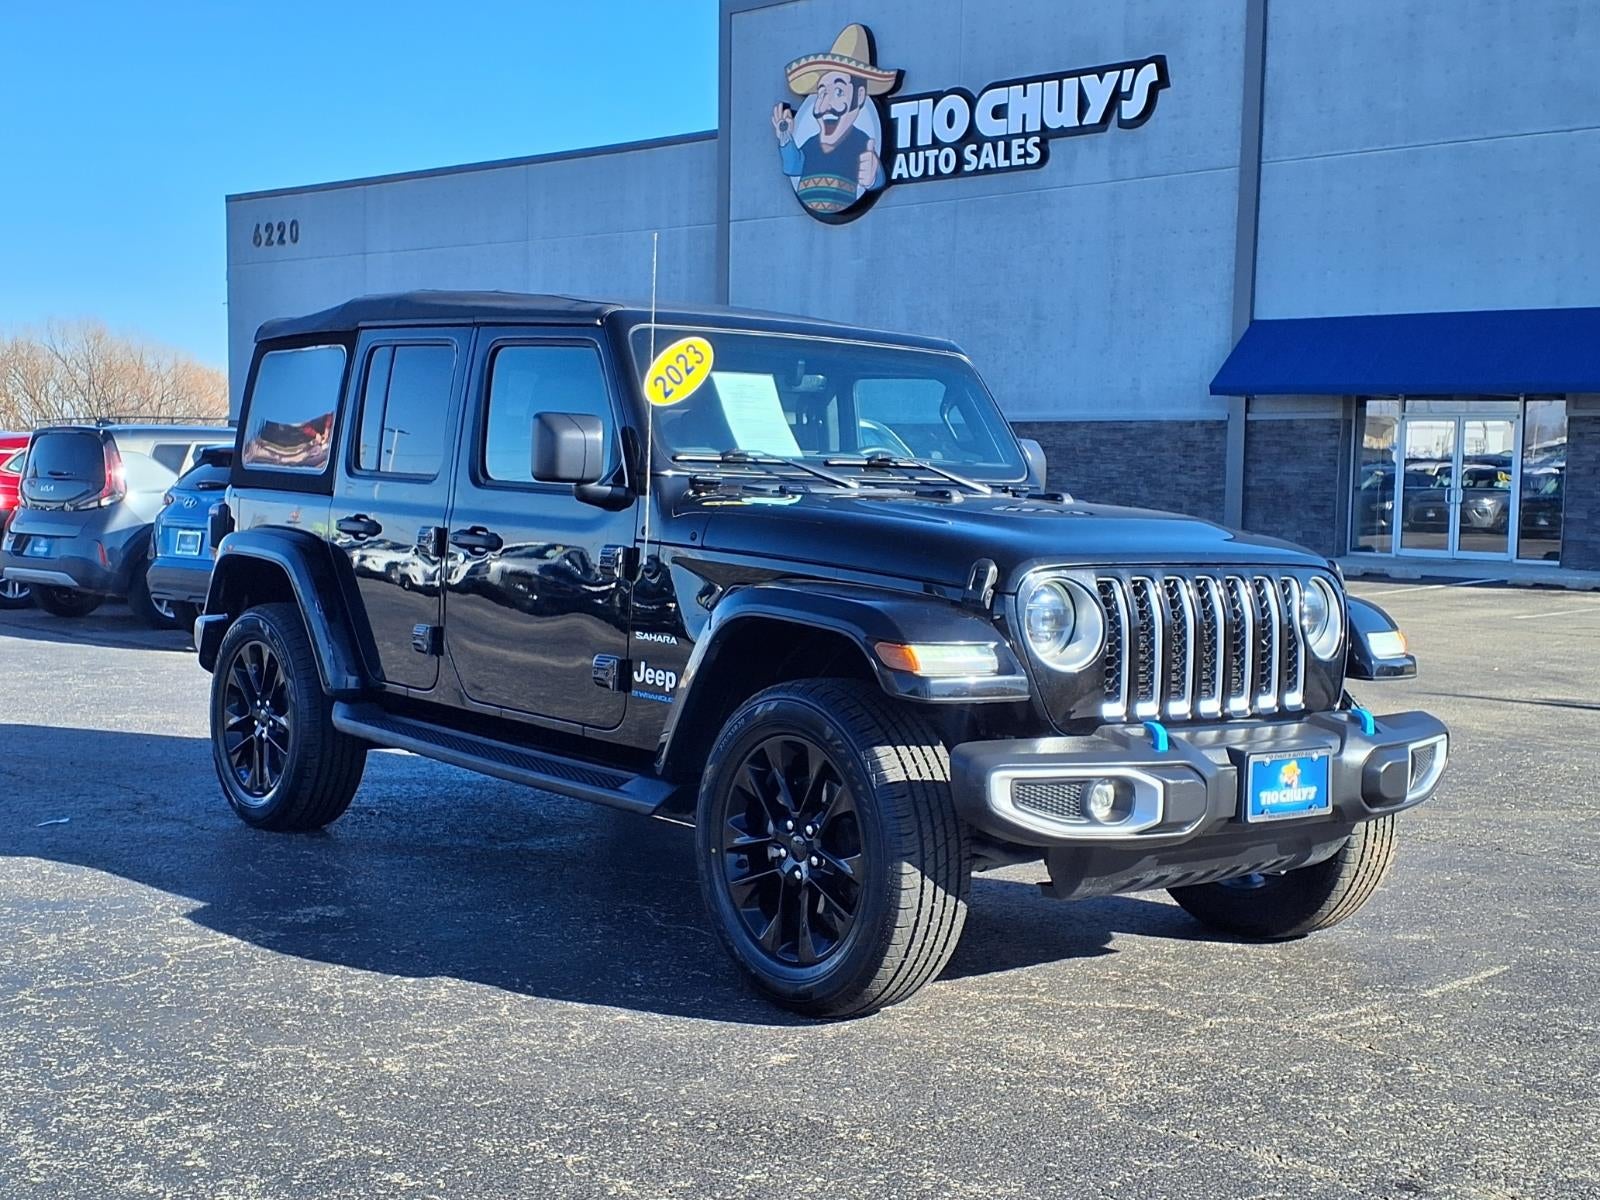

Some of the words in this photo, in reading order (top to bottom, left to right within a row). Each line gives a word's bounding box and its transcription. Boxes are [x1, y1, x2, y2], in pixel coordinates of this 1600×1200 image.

[890, 94, 970, 148] TIO
[975, 63, 1159, 137] CHUY'S
[891, 147, 957, 180] AUTO
[963, 136, 1041, 172] SALES
[252, 219, 299, 248] 6220
[653, 344, 705, 399] 2023
[635, 631, 678, 645] SAHARA
[633, 661, 677, 692] Jeep
